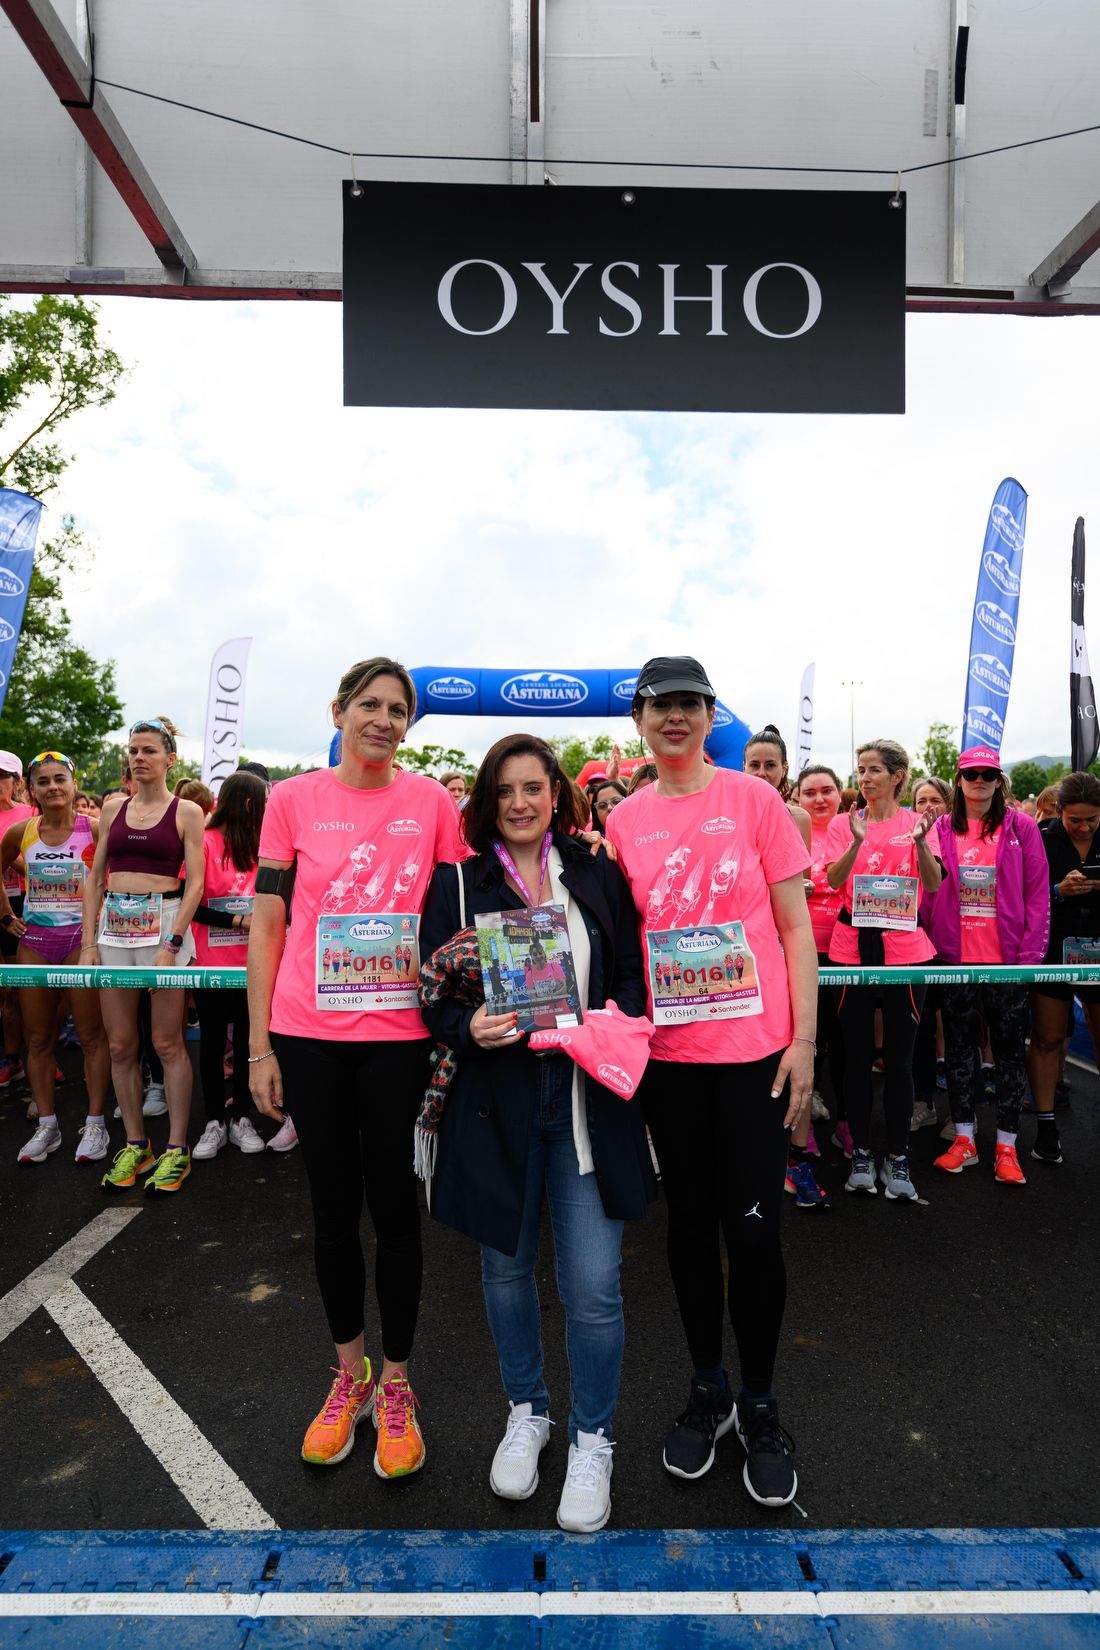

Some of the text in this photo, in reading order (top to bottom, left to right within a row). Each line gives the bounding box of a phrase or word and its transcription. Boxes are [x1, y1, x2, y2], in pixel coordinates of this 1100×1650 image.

[437, 258, 822, 339] OYSHO
[431, 684, 472, 695] ASTURIANA
[508, 683, 581, 700] ASTURIANA
[313, 821, 355, 832] OYSHO
[634, 830, 671, 848] OYSHO
[44, 883, 67, 892] 016
[965, 887, 987, 897] 016
[873, 898, 897, 908] 016
[352, 927, 392, 937] ASTURIANA
[679, 938, 719, 950] ASTURIANA
[352, 955, 393, 972] 016
[47, 973, 84, 984] VITORIA
[156, 975, 193, 986] VITORIA
[362, 975, 382, 983] 1181
[683, 966, 723, 984] 016
[924, 974, 961, 984] VITORIA
[1034, 973, 1071, 982] VITORIA
[698, 987, 708, 995] 64
[328, 995, 413, 1005] OYSHO Santander
[656, 998, 679, 1006] CARRERA
[664, 1003, 750, 1019] OYSHO Santander
[600, 1067, 630, 1092] ASTURIANA
